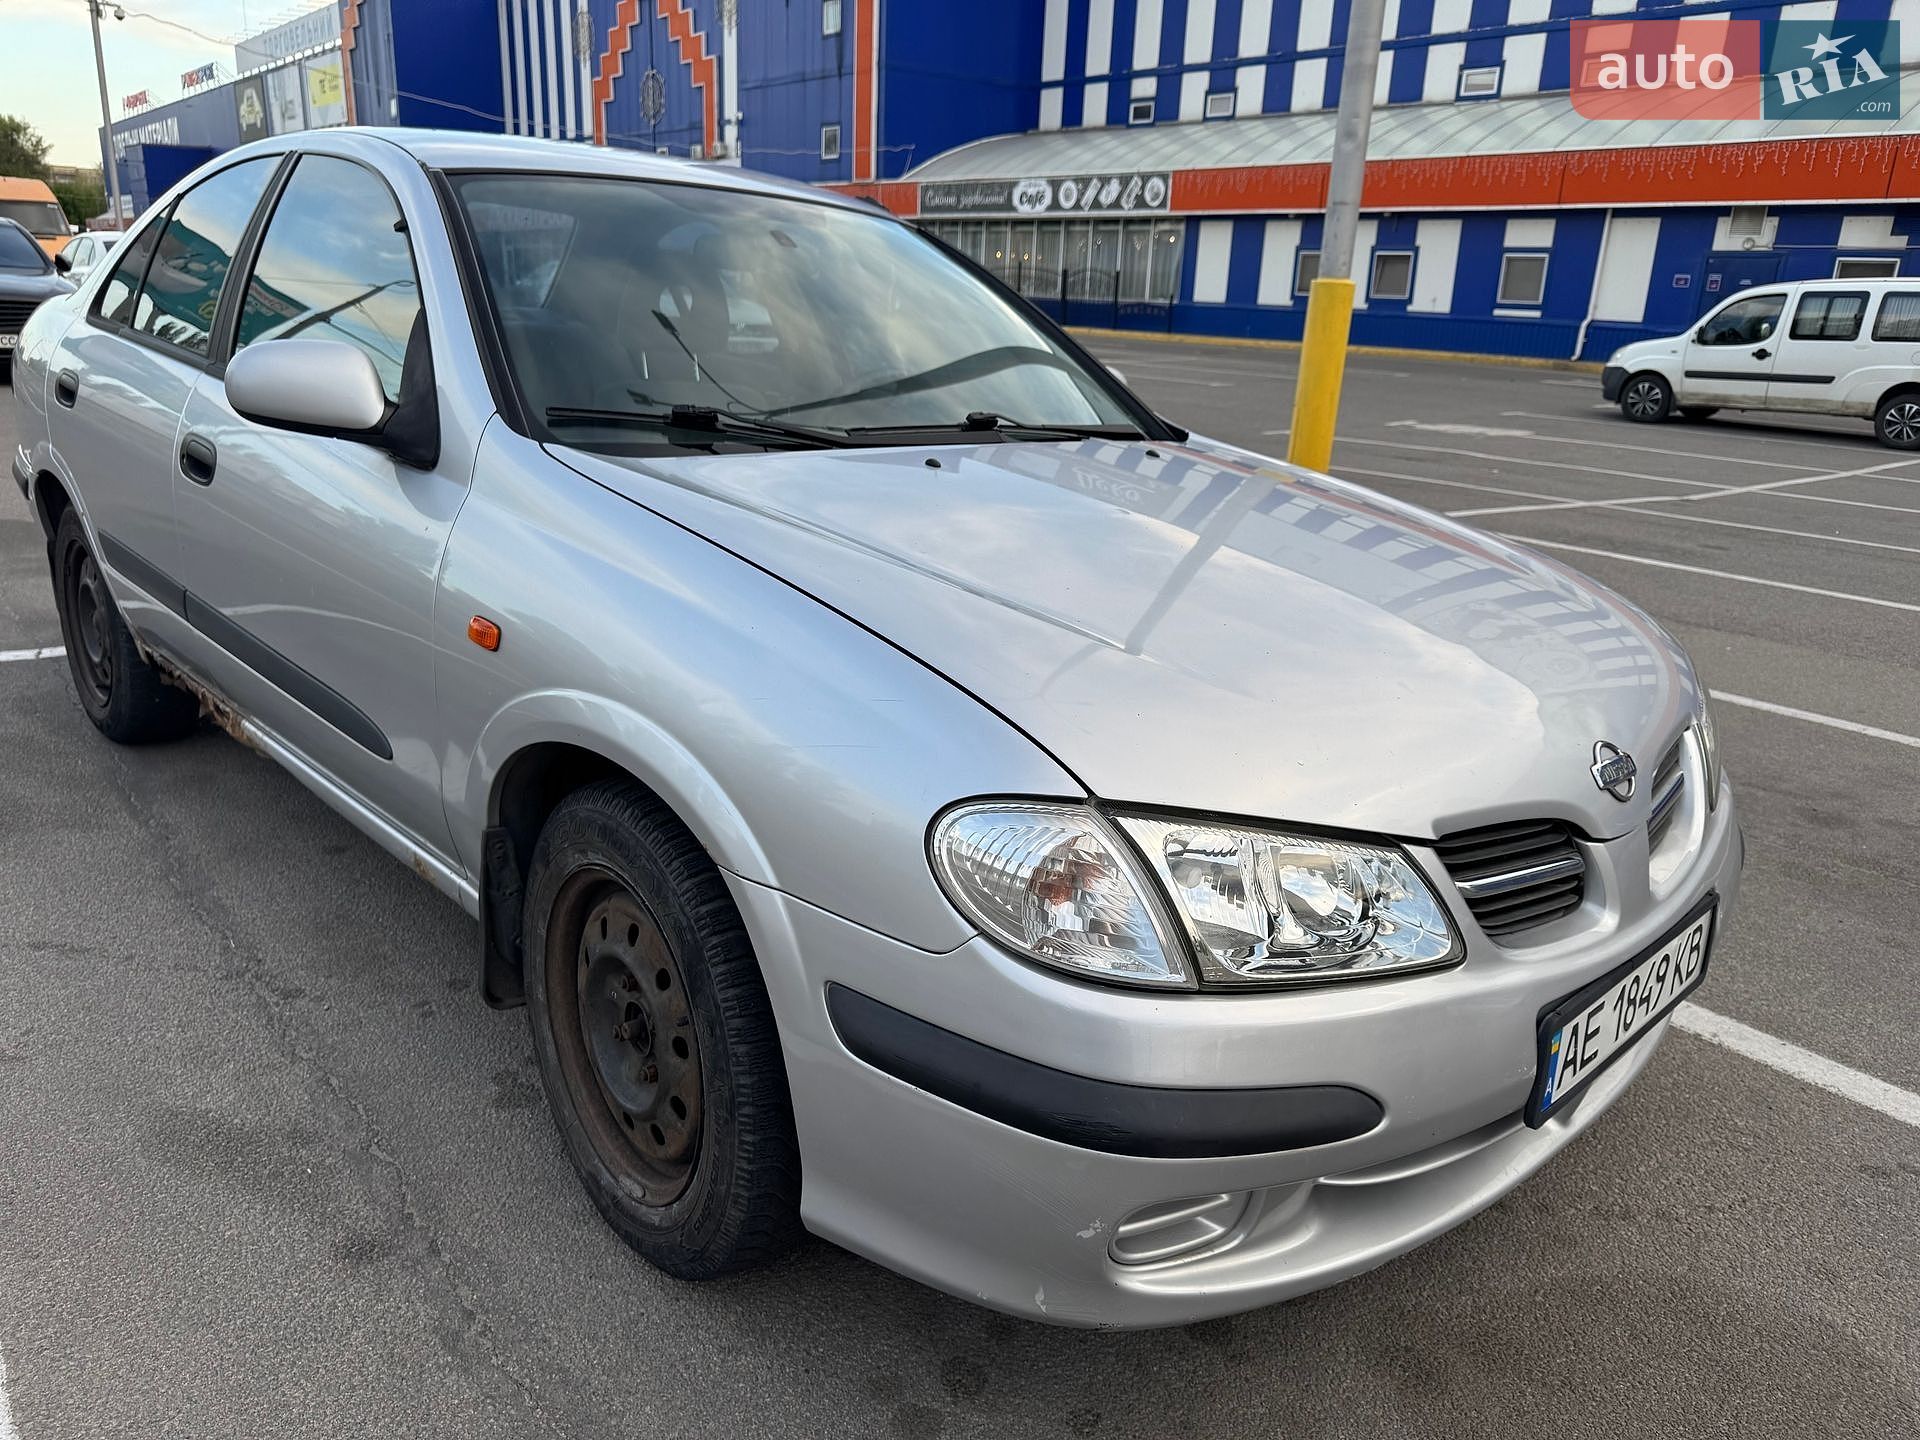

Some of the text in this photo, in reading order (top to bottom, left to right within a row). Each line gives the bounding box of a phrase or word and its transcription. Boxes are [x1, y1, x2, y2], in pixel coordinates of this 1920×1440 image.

[1556, 923, 1704, 1091] AE 1849 KB
